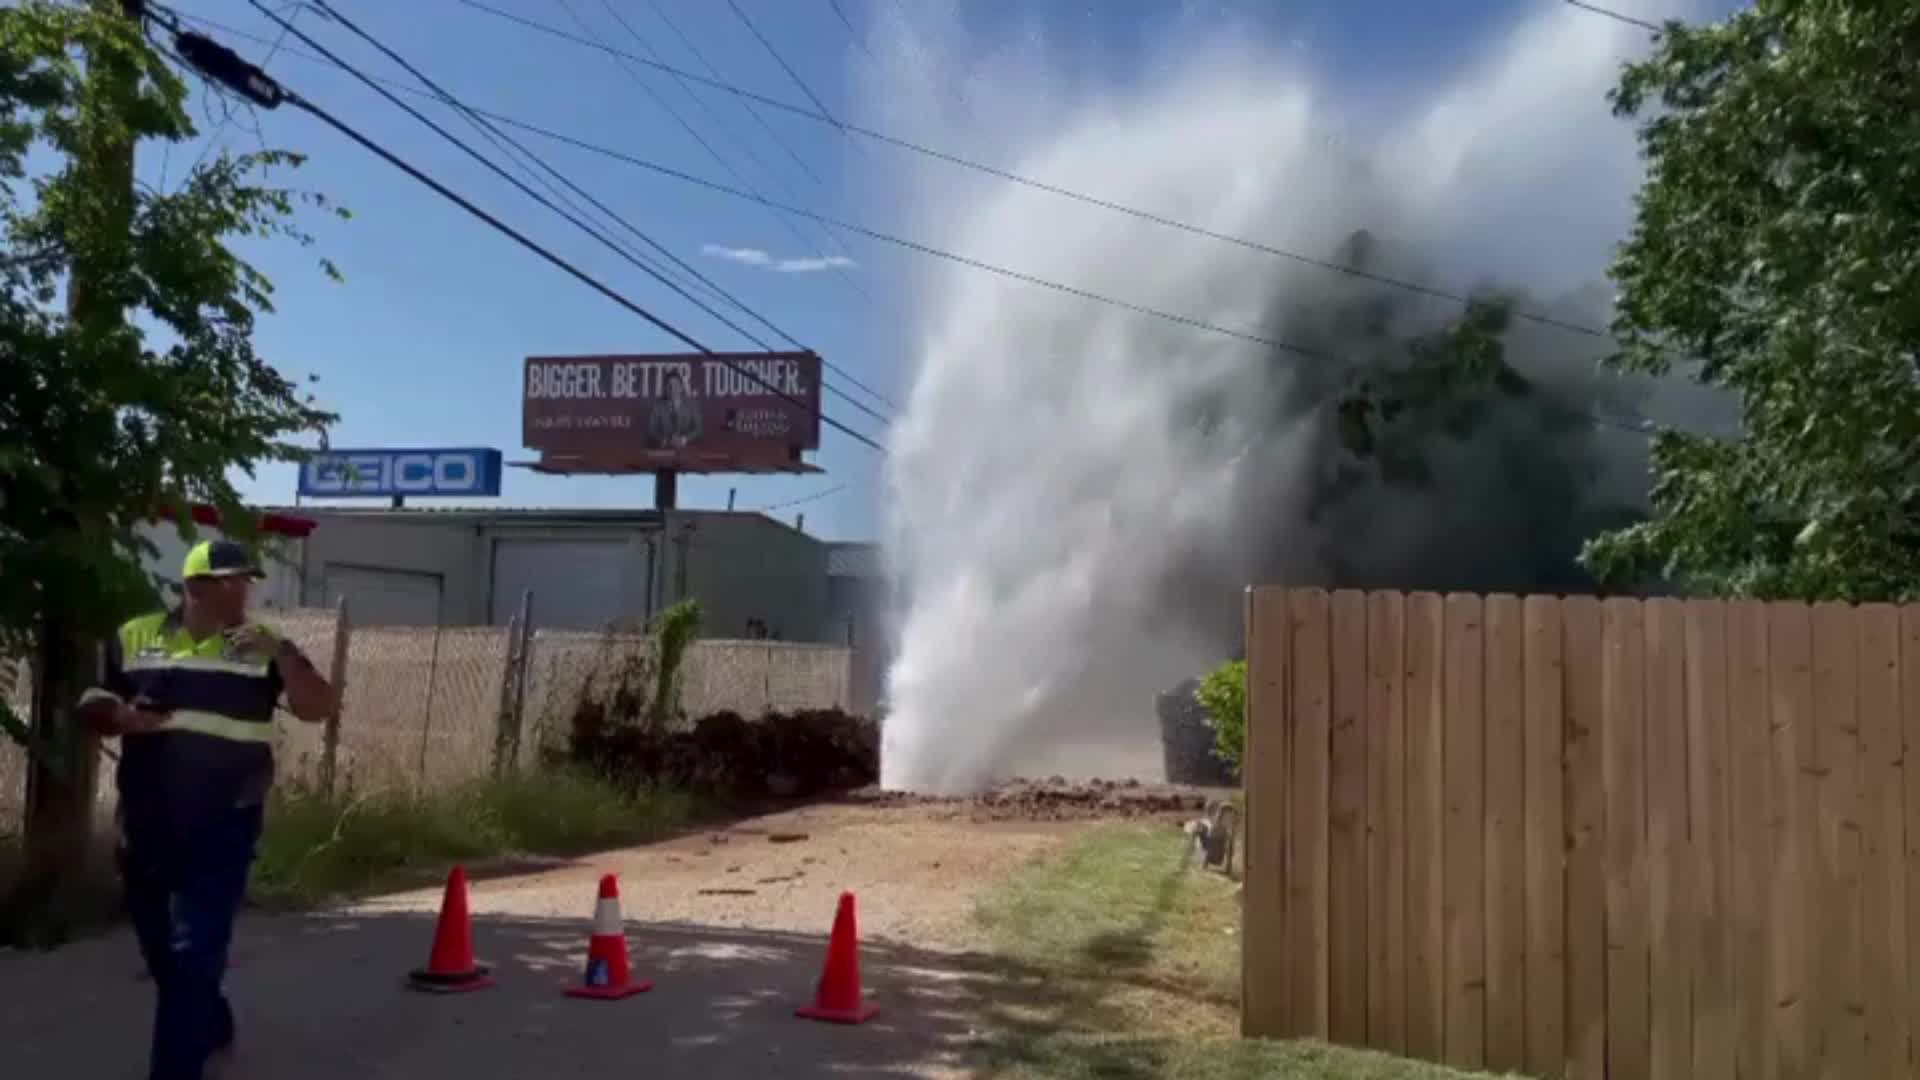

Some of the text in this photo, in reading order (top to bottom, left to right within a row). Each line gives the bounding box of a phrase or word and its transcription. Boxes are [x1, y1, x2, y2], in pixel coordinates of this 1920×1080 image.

[528, 363, 606, 399] BIGGER.
[611, 361, 698, 398] BETTR.
[306, 453, 476, 490] GEICO
